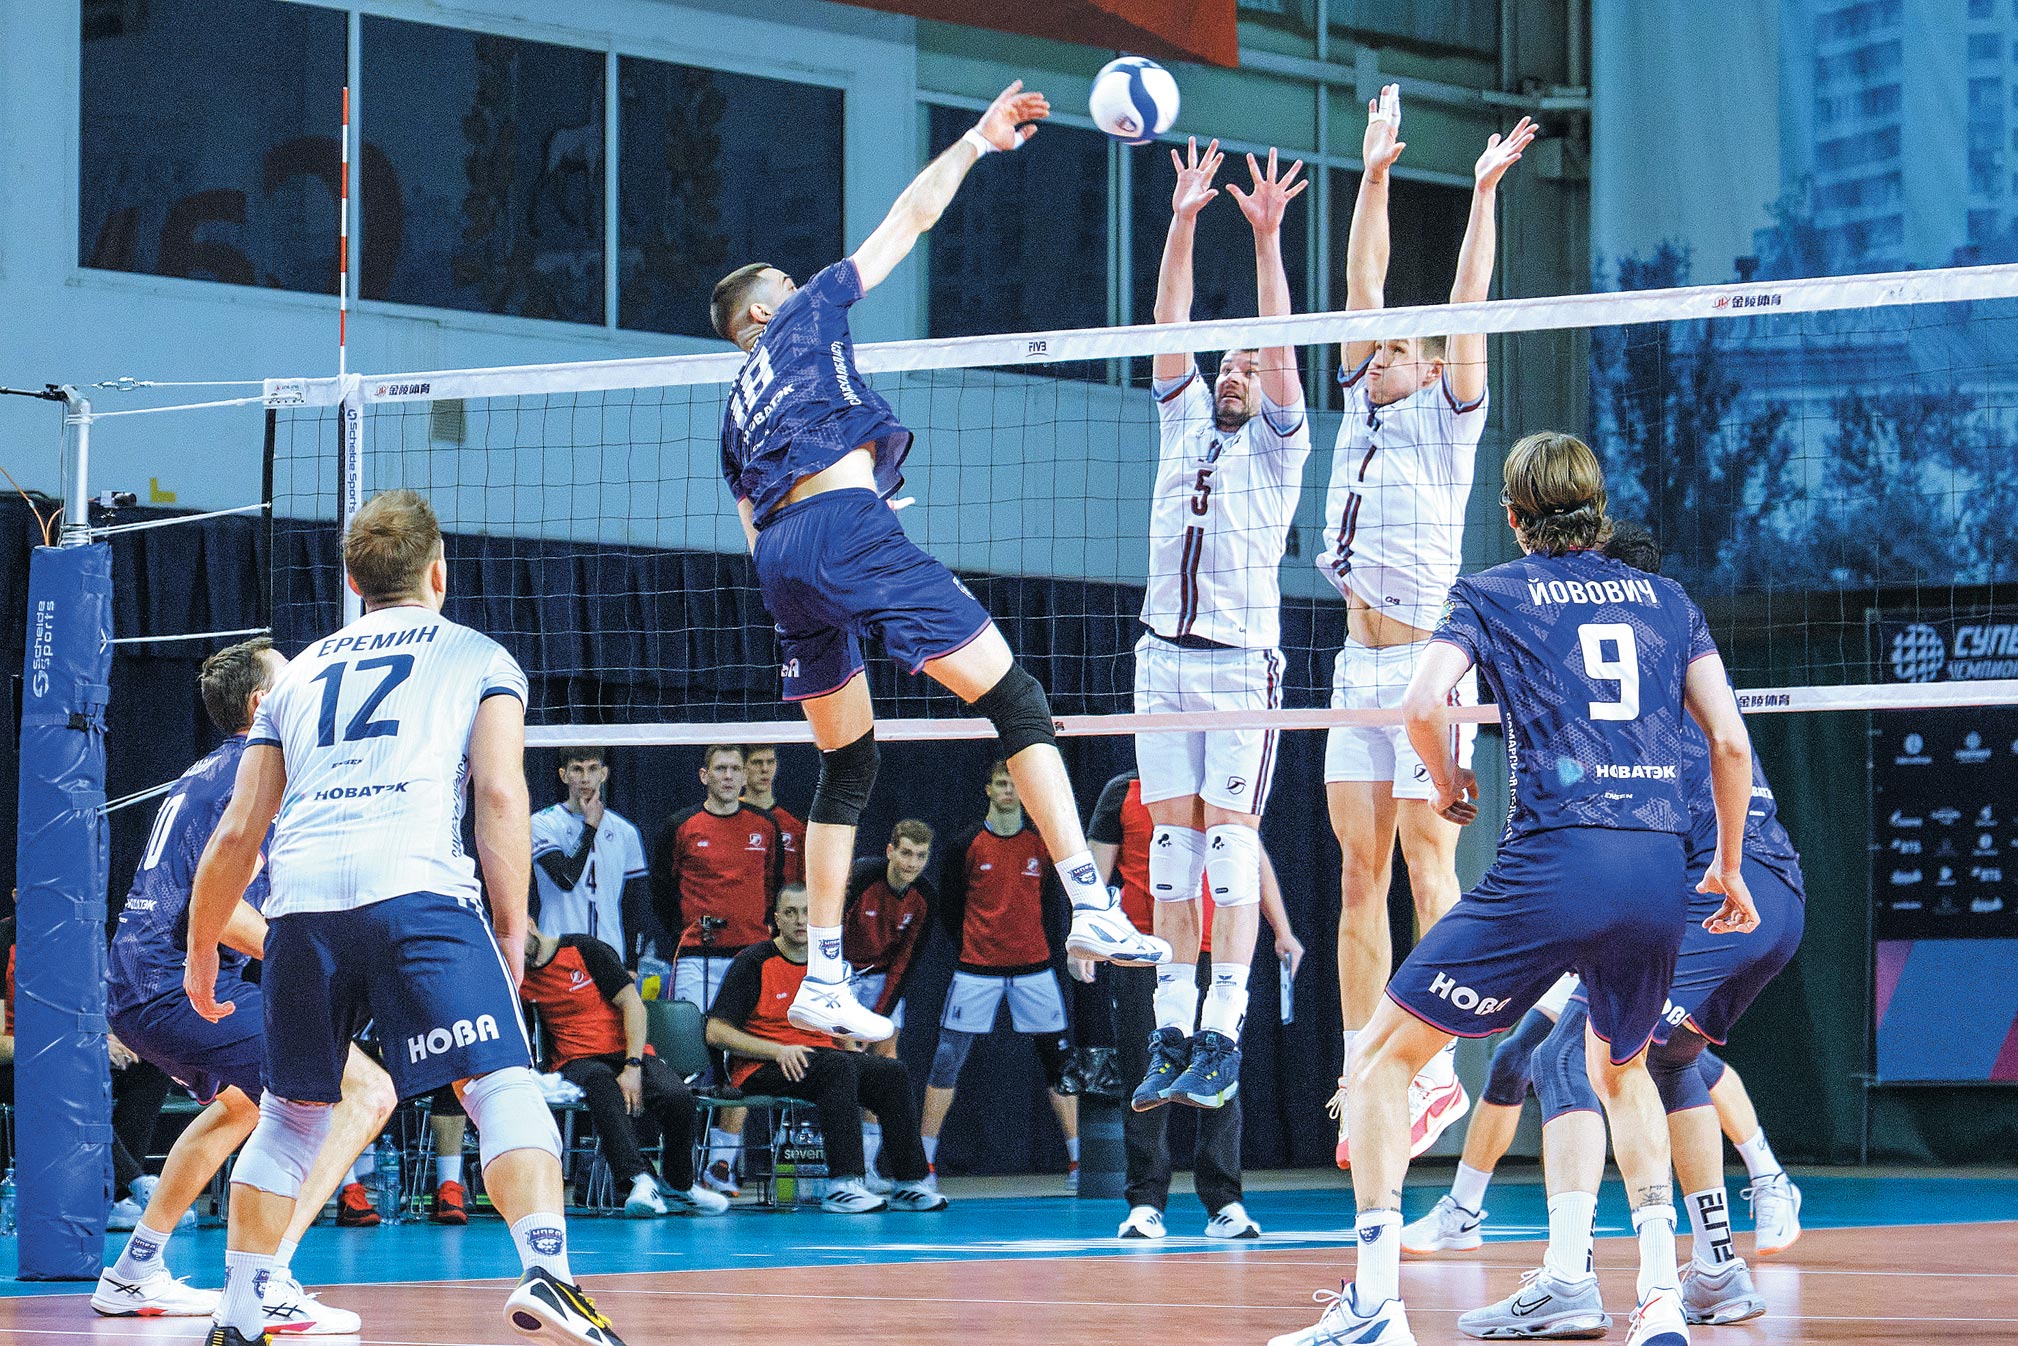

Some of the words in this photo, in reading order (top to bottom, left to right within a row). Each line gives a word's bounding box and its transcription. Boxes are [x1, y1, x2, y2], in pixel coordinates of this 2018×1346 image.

[1731, 293, 1782, 308] 金陵体育
[389, 383, 431, 396] 金陵体育
[348, 421, 358, 471] Schelde
[348, 473, 358, 514] Sports
[1190, 469, 1213, 516] 5
[1527, 578, 1658, 606] ЙОВОВИЧ
[32, 600, 46, 670] Schelde
[40, 600, 55, 670] Sports
[317, 625, 440, 658] ЕРЕМИН
[1577, 623, 1640, 721] 9
[309, 653, 416, 748] 12
[1739, 694, 1790, 708] 金陵体育
[1595, 764, 1677, 780] НОВАТЭК
[585, 859, 597, 895] 4
[407, 1014, 500, 1064] НОВА
